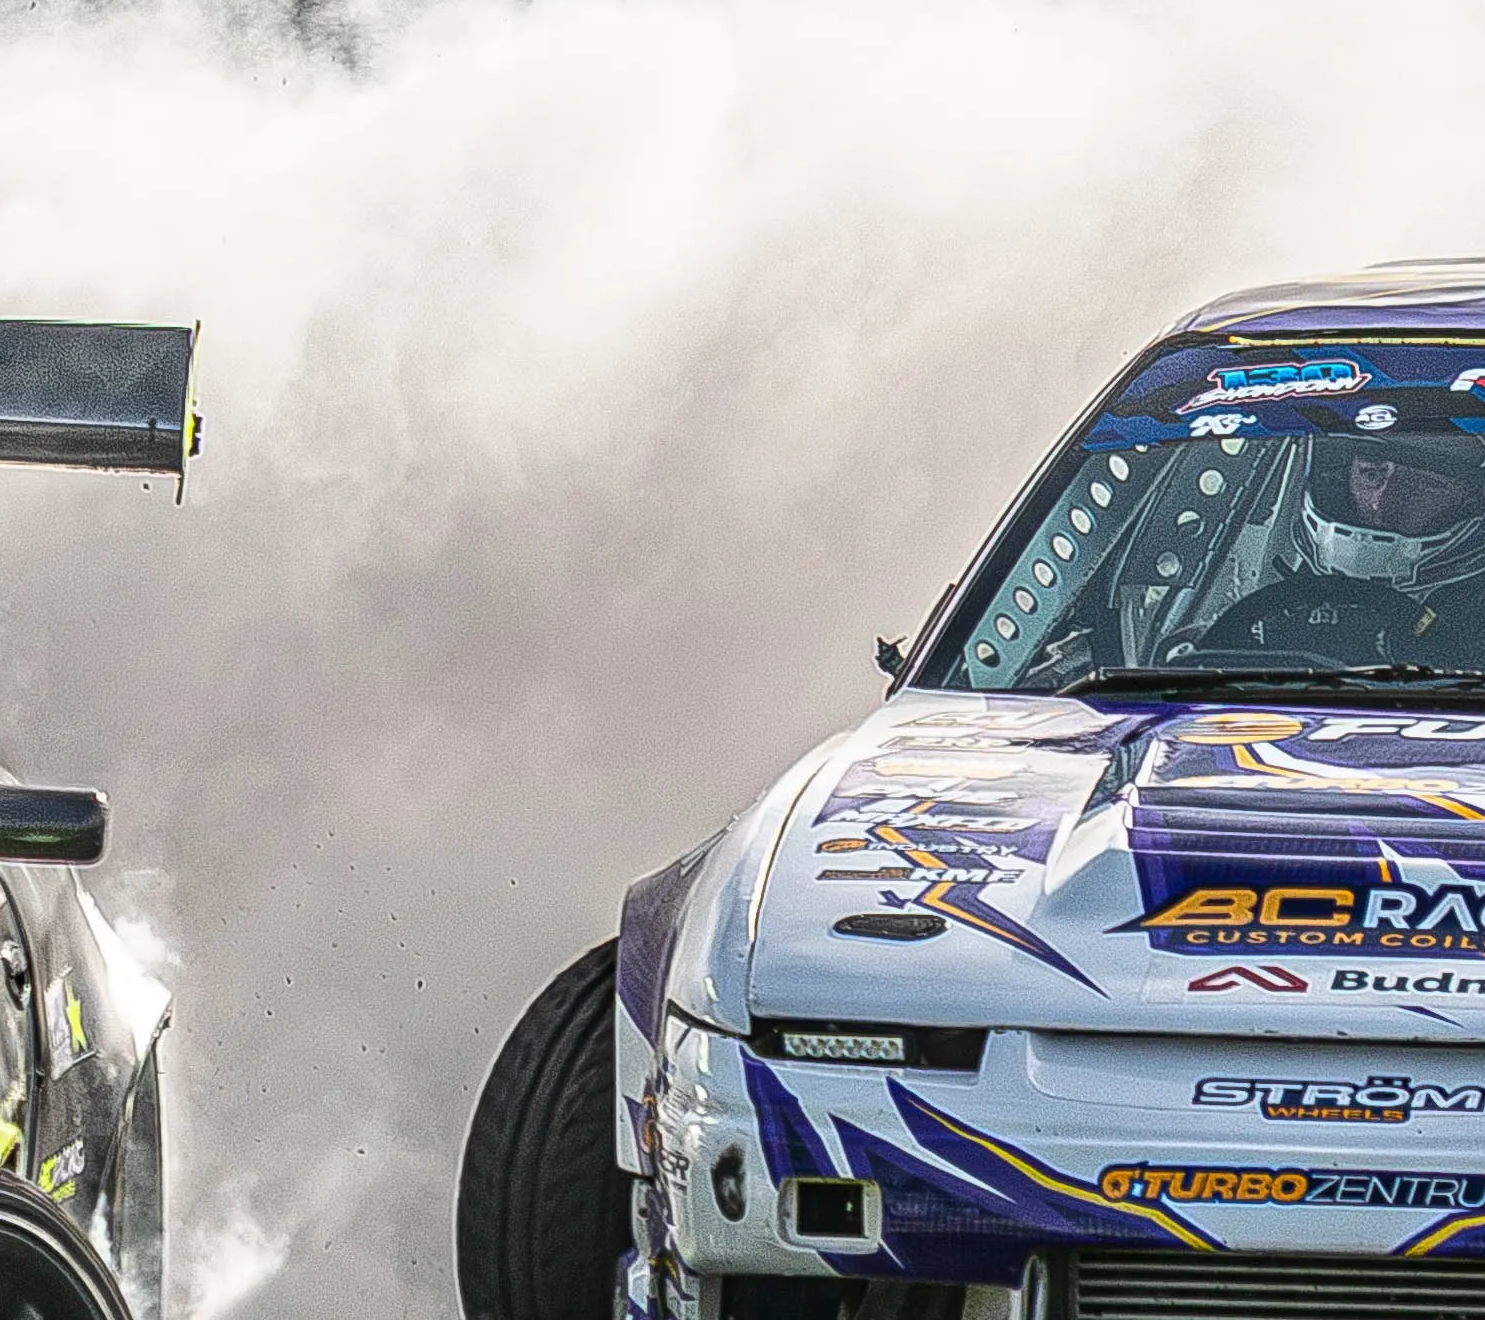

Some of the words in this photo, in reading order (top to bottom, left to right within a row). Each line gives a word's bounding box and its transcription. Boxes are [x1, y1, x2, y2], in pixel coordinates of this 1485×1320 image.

[1218, 363, 1353, 391] 130
[1139, 889, 1354, 927] BC
[1186, 931, 1363, 945] CUSTOM
[1200, 1078, 1481, 1109] STRÖM
[1266, 1106, 1404, 1121] WHEELS
